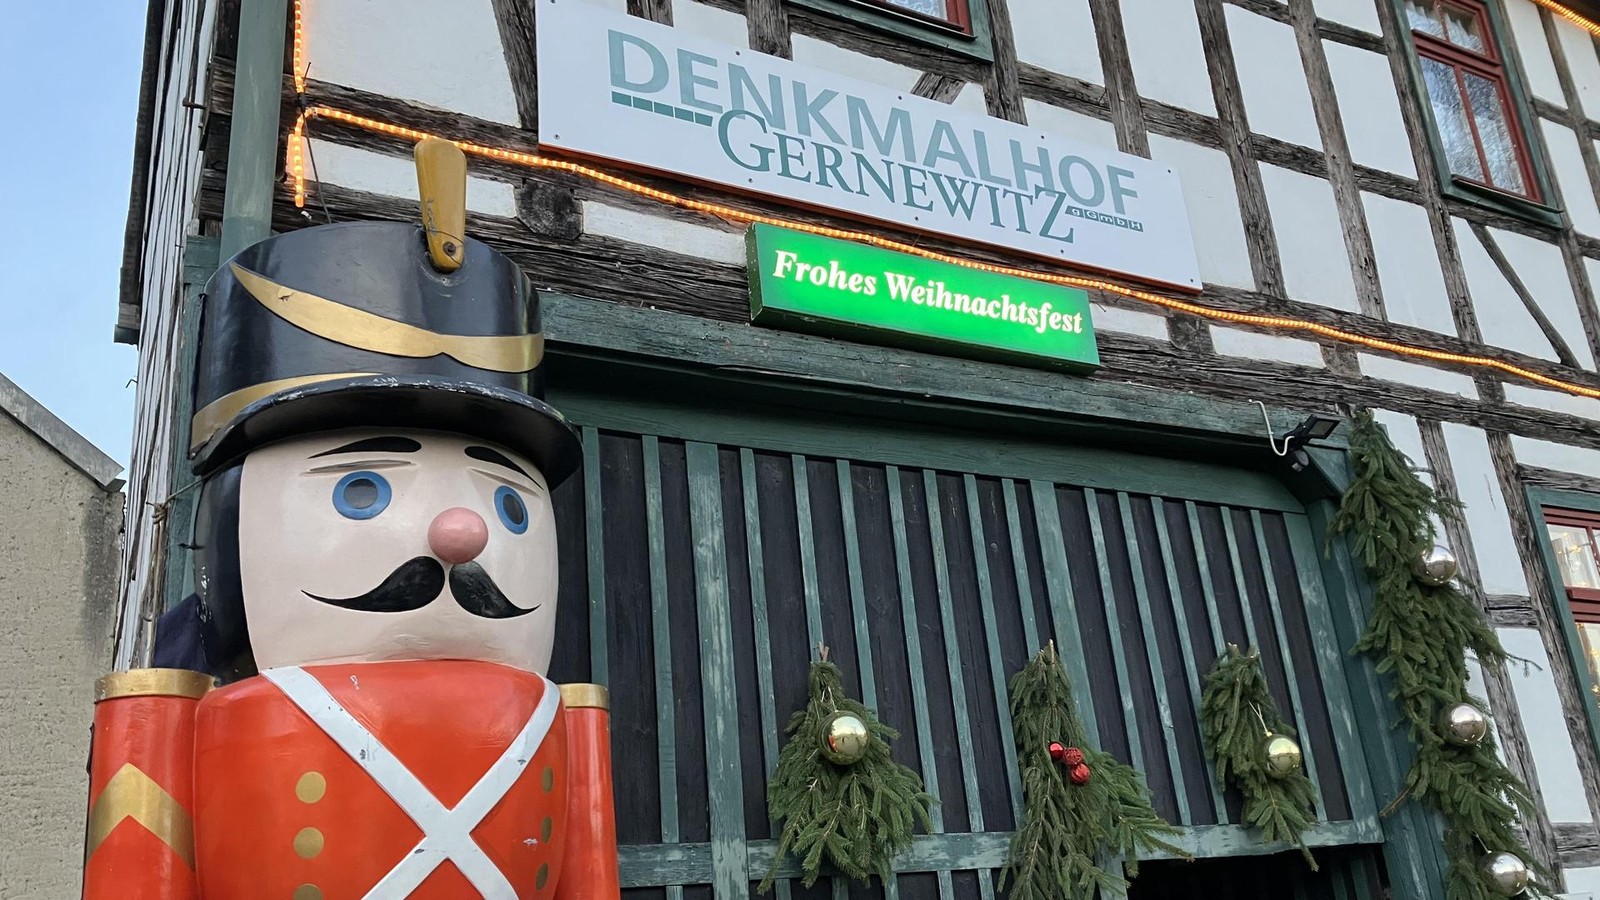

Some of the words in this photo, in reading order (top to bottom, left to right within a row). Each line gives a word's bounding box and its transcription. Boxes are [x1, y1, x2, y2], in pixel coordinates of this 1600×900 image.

[607, 28, 1138, 215] DENKMALHOF
[717, 109, 1074, 244] GERNEWITZ
[1069, 206, 1142, 231] gGmbH
[772, 249, 877, 297] Frohes
[884, 271, 1083, 334] Weihnachtsfest
